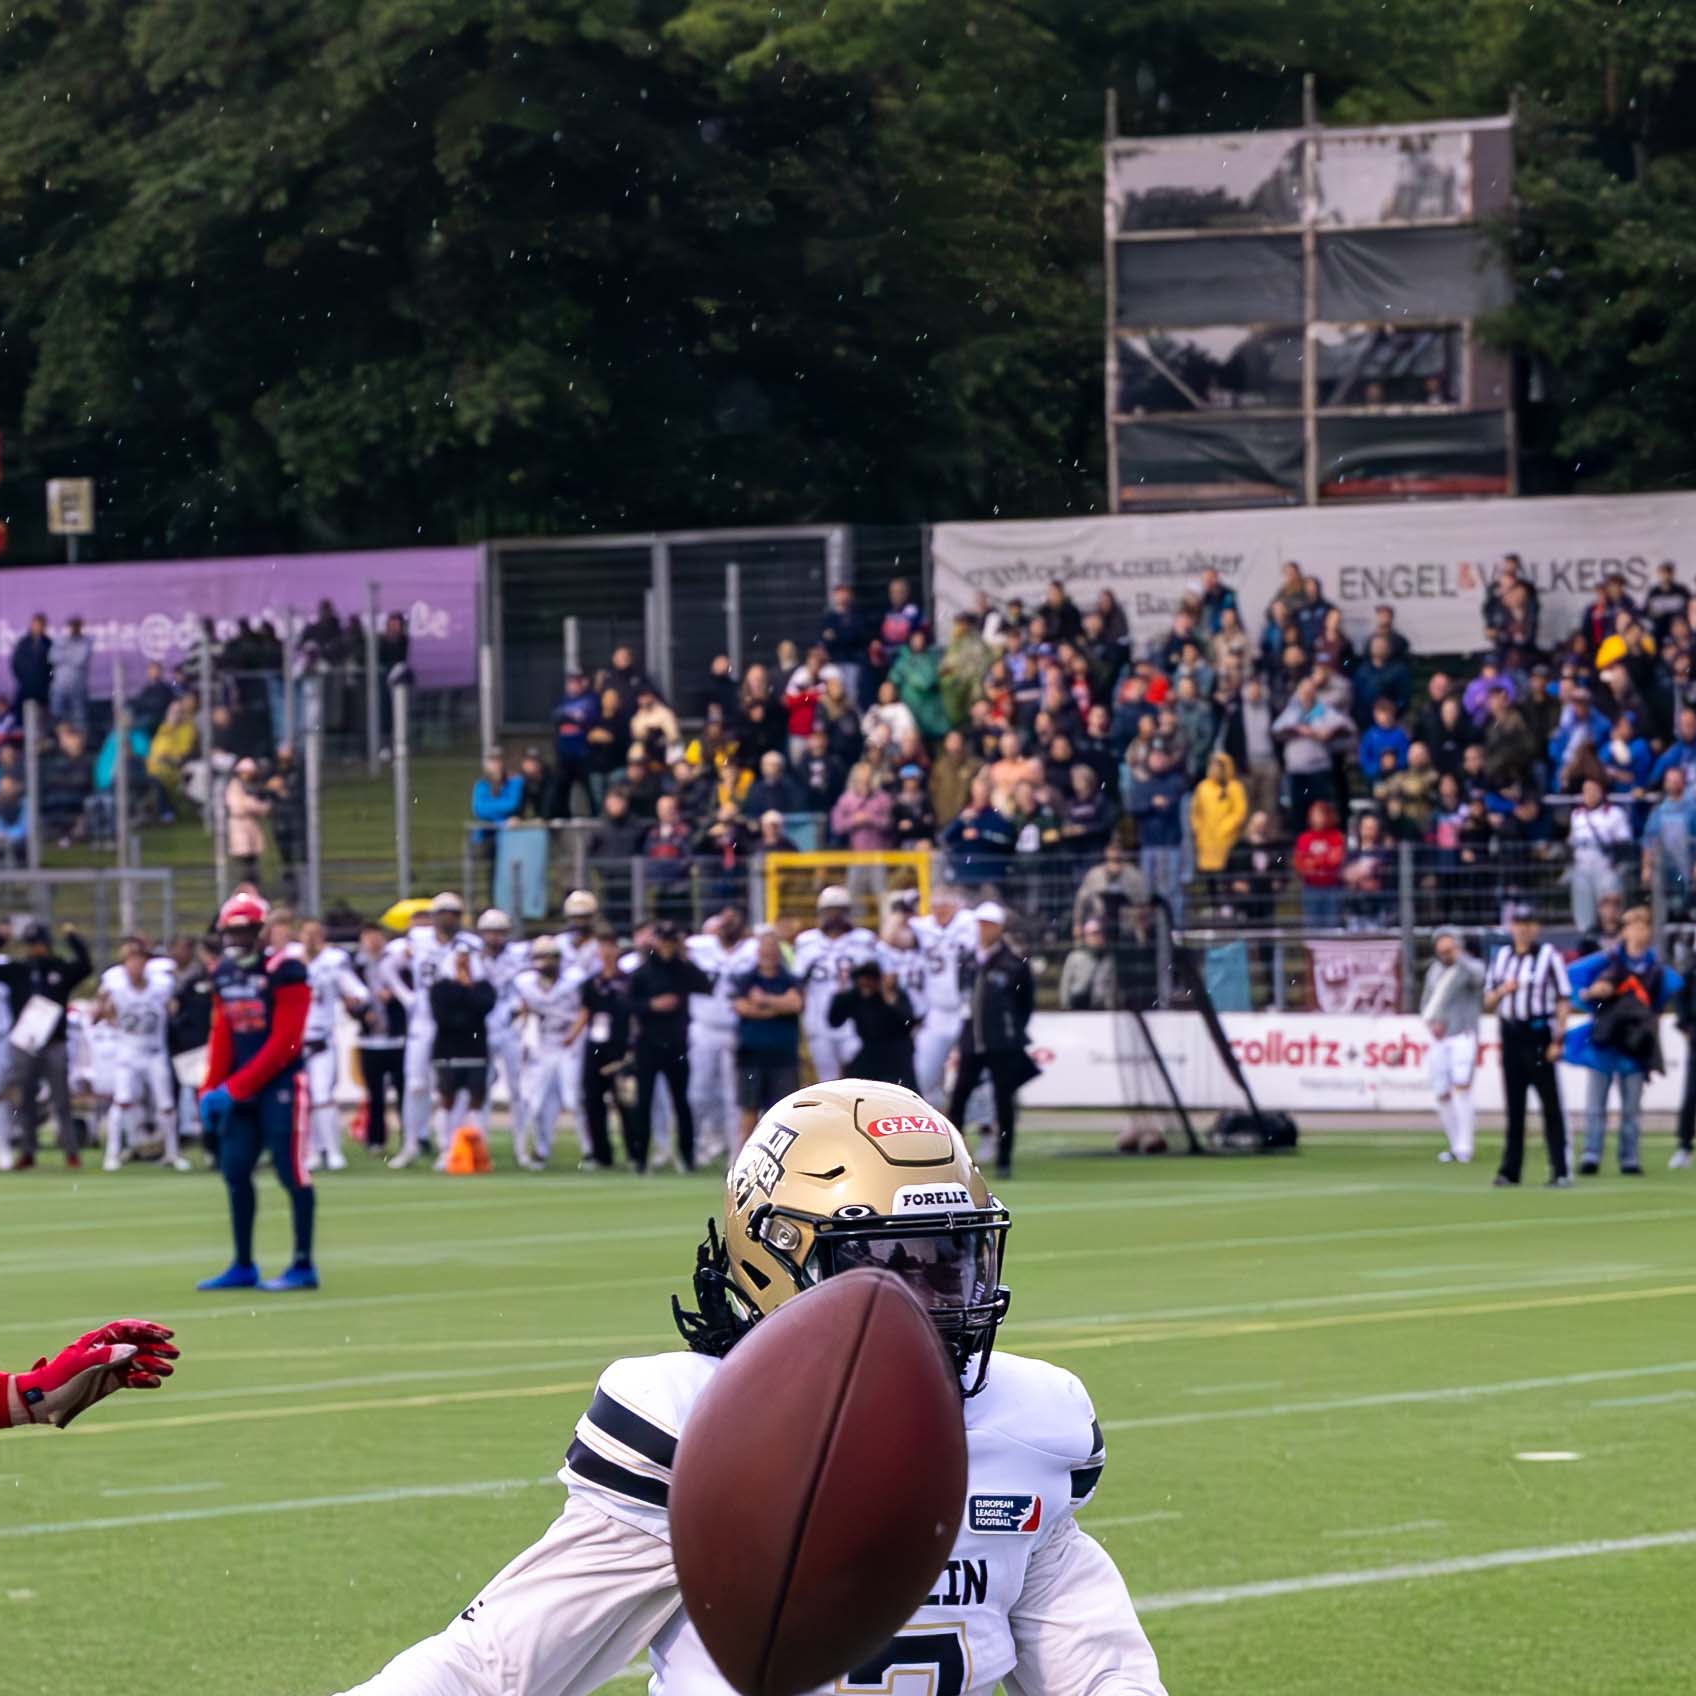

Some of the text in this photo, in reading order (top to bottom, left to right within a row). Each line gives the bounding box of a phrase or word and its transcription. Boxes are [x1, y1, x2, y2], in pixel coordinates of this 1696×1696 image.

[904, 1191, 968, 1206] FORELLE
[975, 1500, 1013, 1508] EUROPEAN
[975, 1509, 1003, 1517] LEAGUE
[975, 1518, 1011, 1526] FOOTBALL
